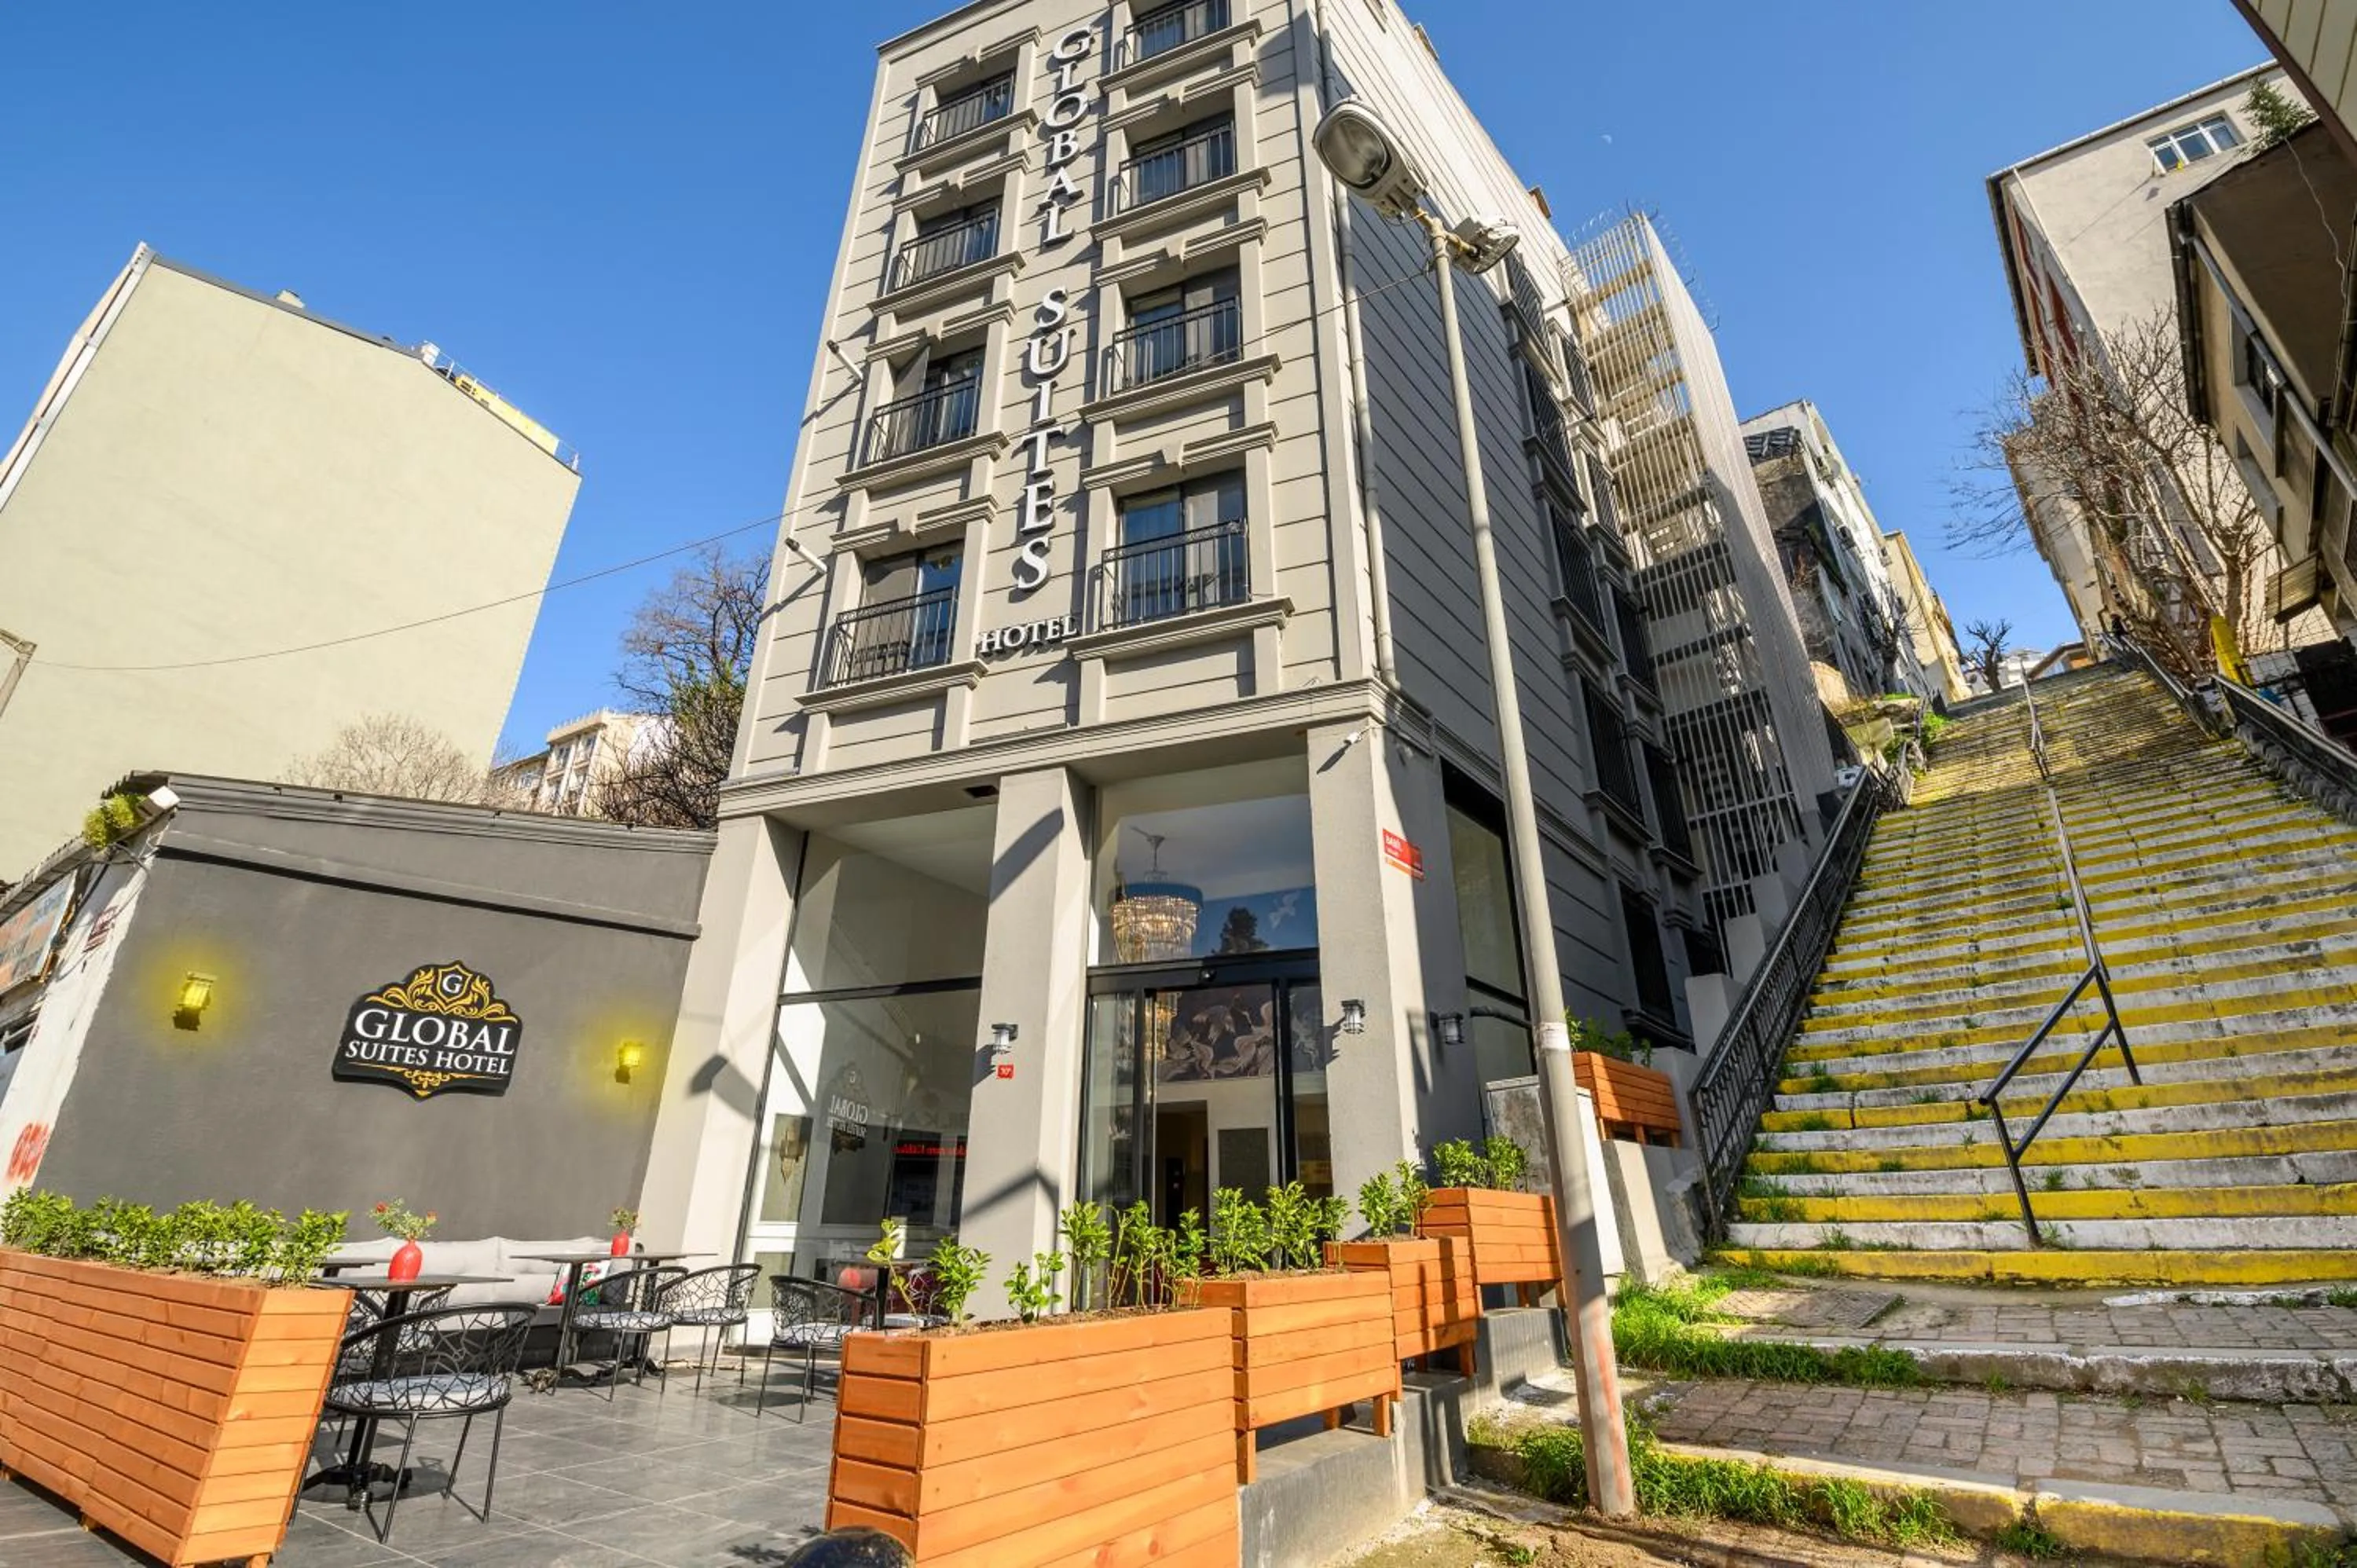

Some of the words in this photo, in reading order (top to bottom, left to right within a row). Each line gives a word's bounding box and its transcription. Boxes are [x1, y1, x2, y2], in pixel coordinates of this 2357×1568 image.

[1043, 24, 1093, 244] GLOBAL
[1017, 286, 1075, 590] SUITES
[979, 615, 1077, 653] HOTEL
[442, 973, 464, 994] G
[354, 1008, 515, 1056] GLOBAL
[345, 1040, 429, 1066] SUITES
[434, 1050, 509, 1075] HOTEL
